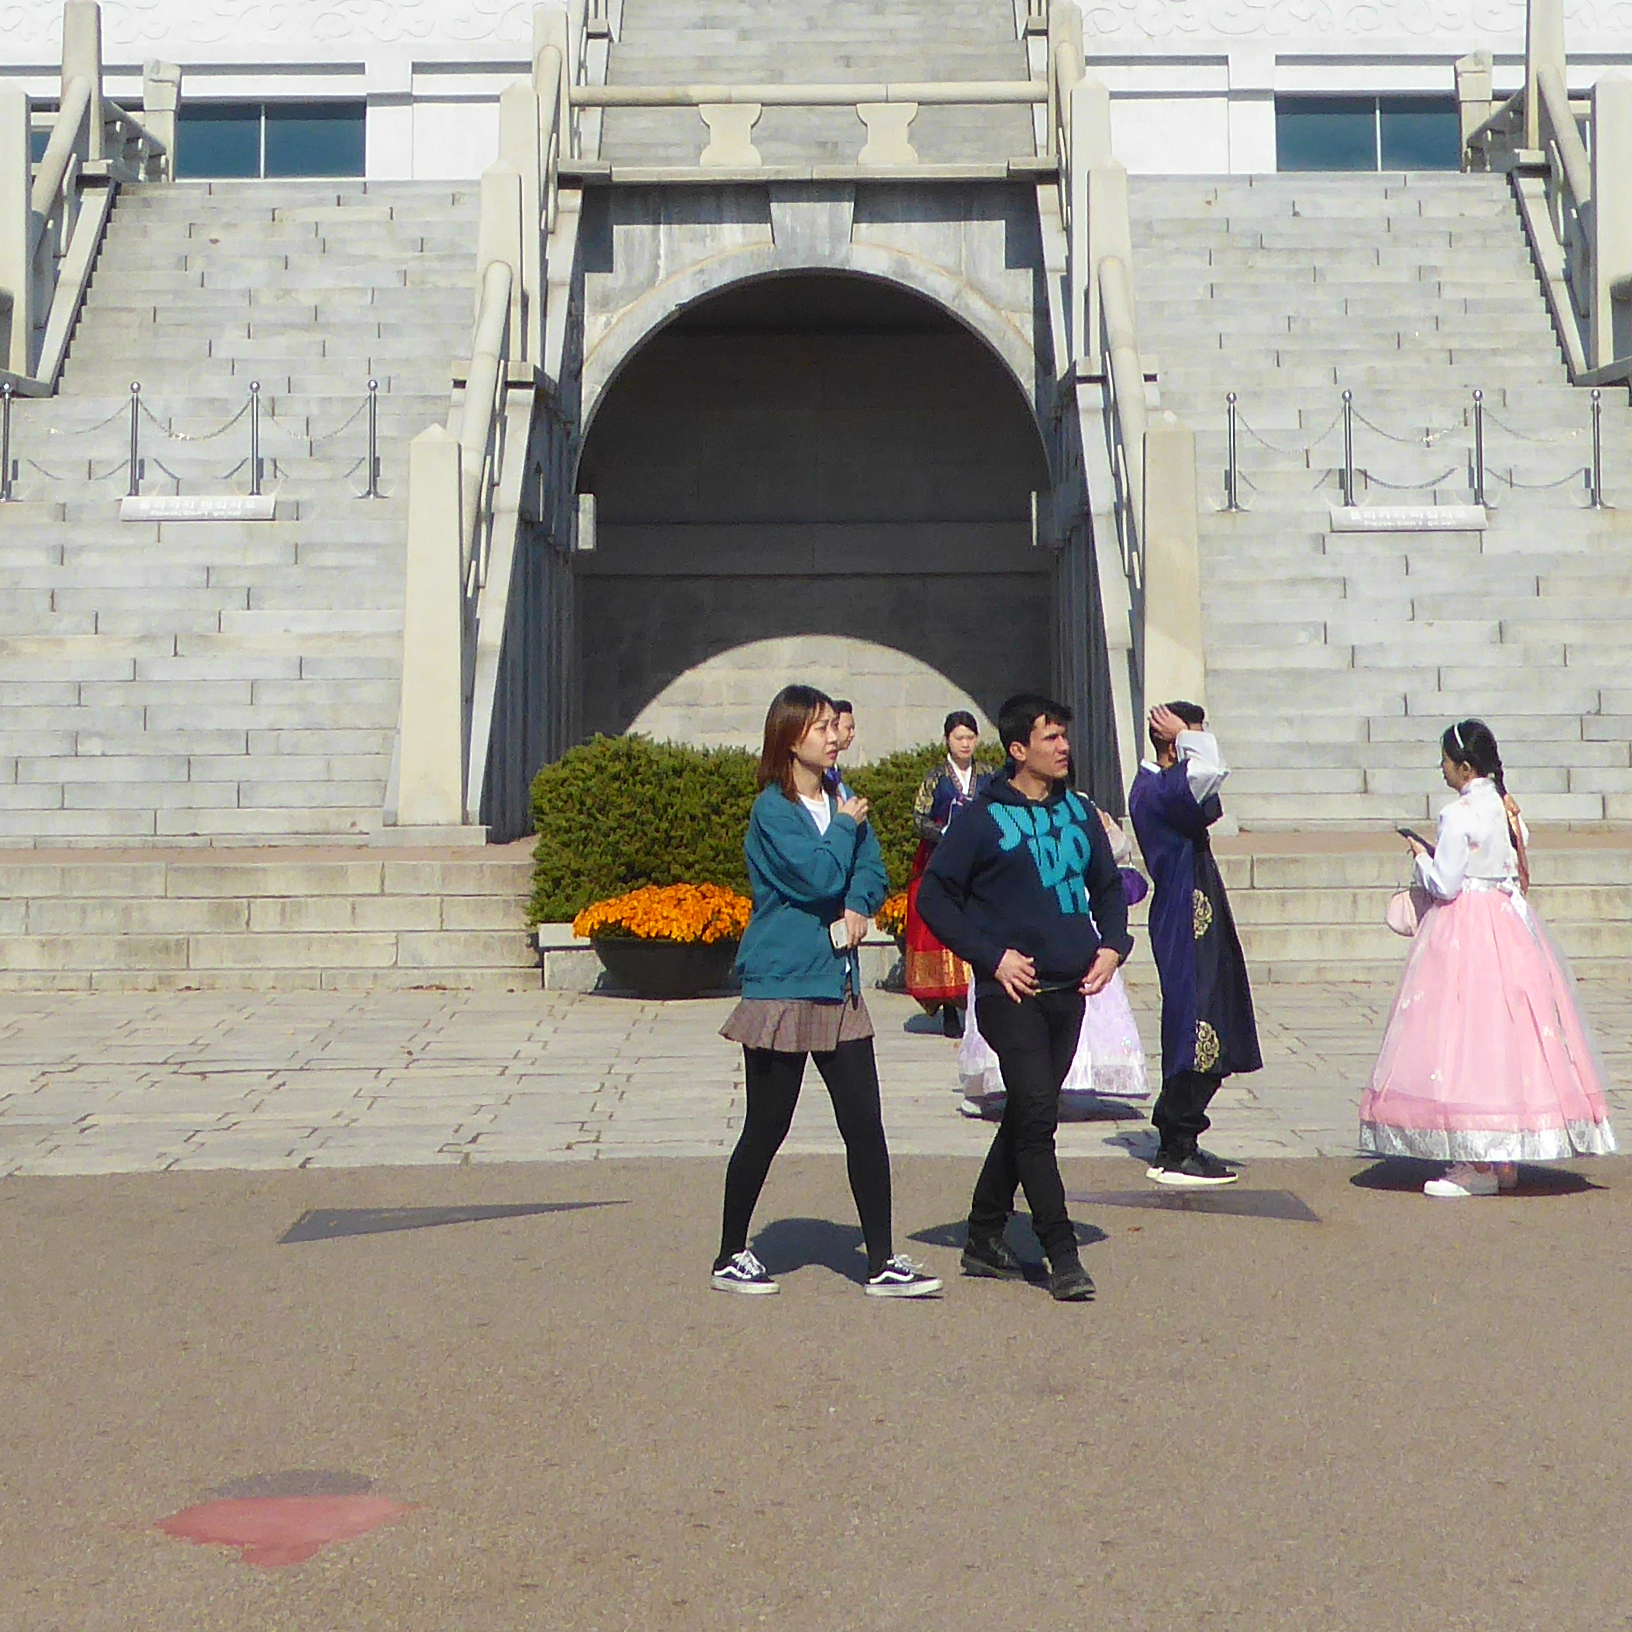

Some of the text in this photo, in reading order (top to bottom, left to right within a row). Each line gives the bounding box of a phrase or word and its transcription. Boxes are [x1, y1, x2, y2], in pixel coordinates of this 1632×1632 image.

[988, 788, 1088, 851] JUST
[1027, 824, 1091, 888] DO
[1056, 875, 1089, 914] IT
